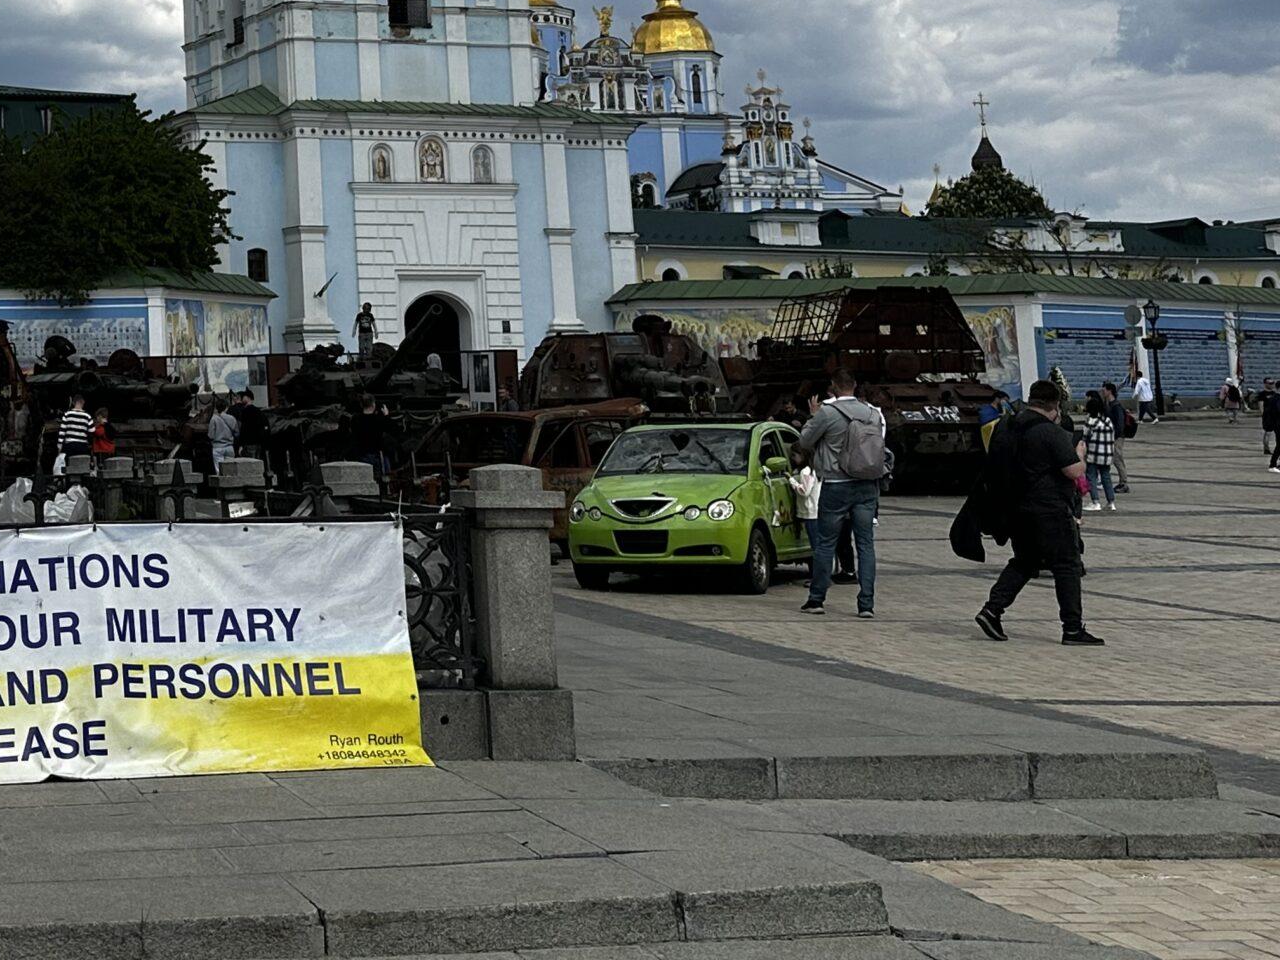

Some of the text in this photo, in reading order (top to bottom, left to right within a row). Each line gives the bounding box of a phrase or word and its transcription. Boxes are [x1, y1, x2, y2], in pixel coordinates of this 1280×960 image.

[106, 607, 301, 643] MILITARY
[93, 662, 361, 699] PERSONNEL
[329, 733, 404, 748] Ryan Routh
